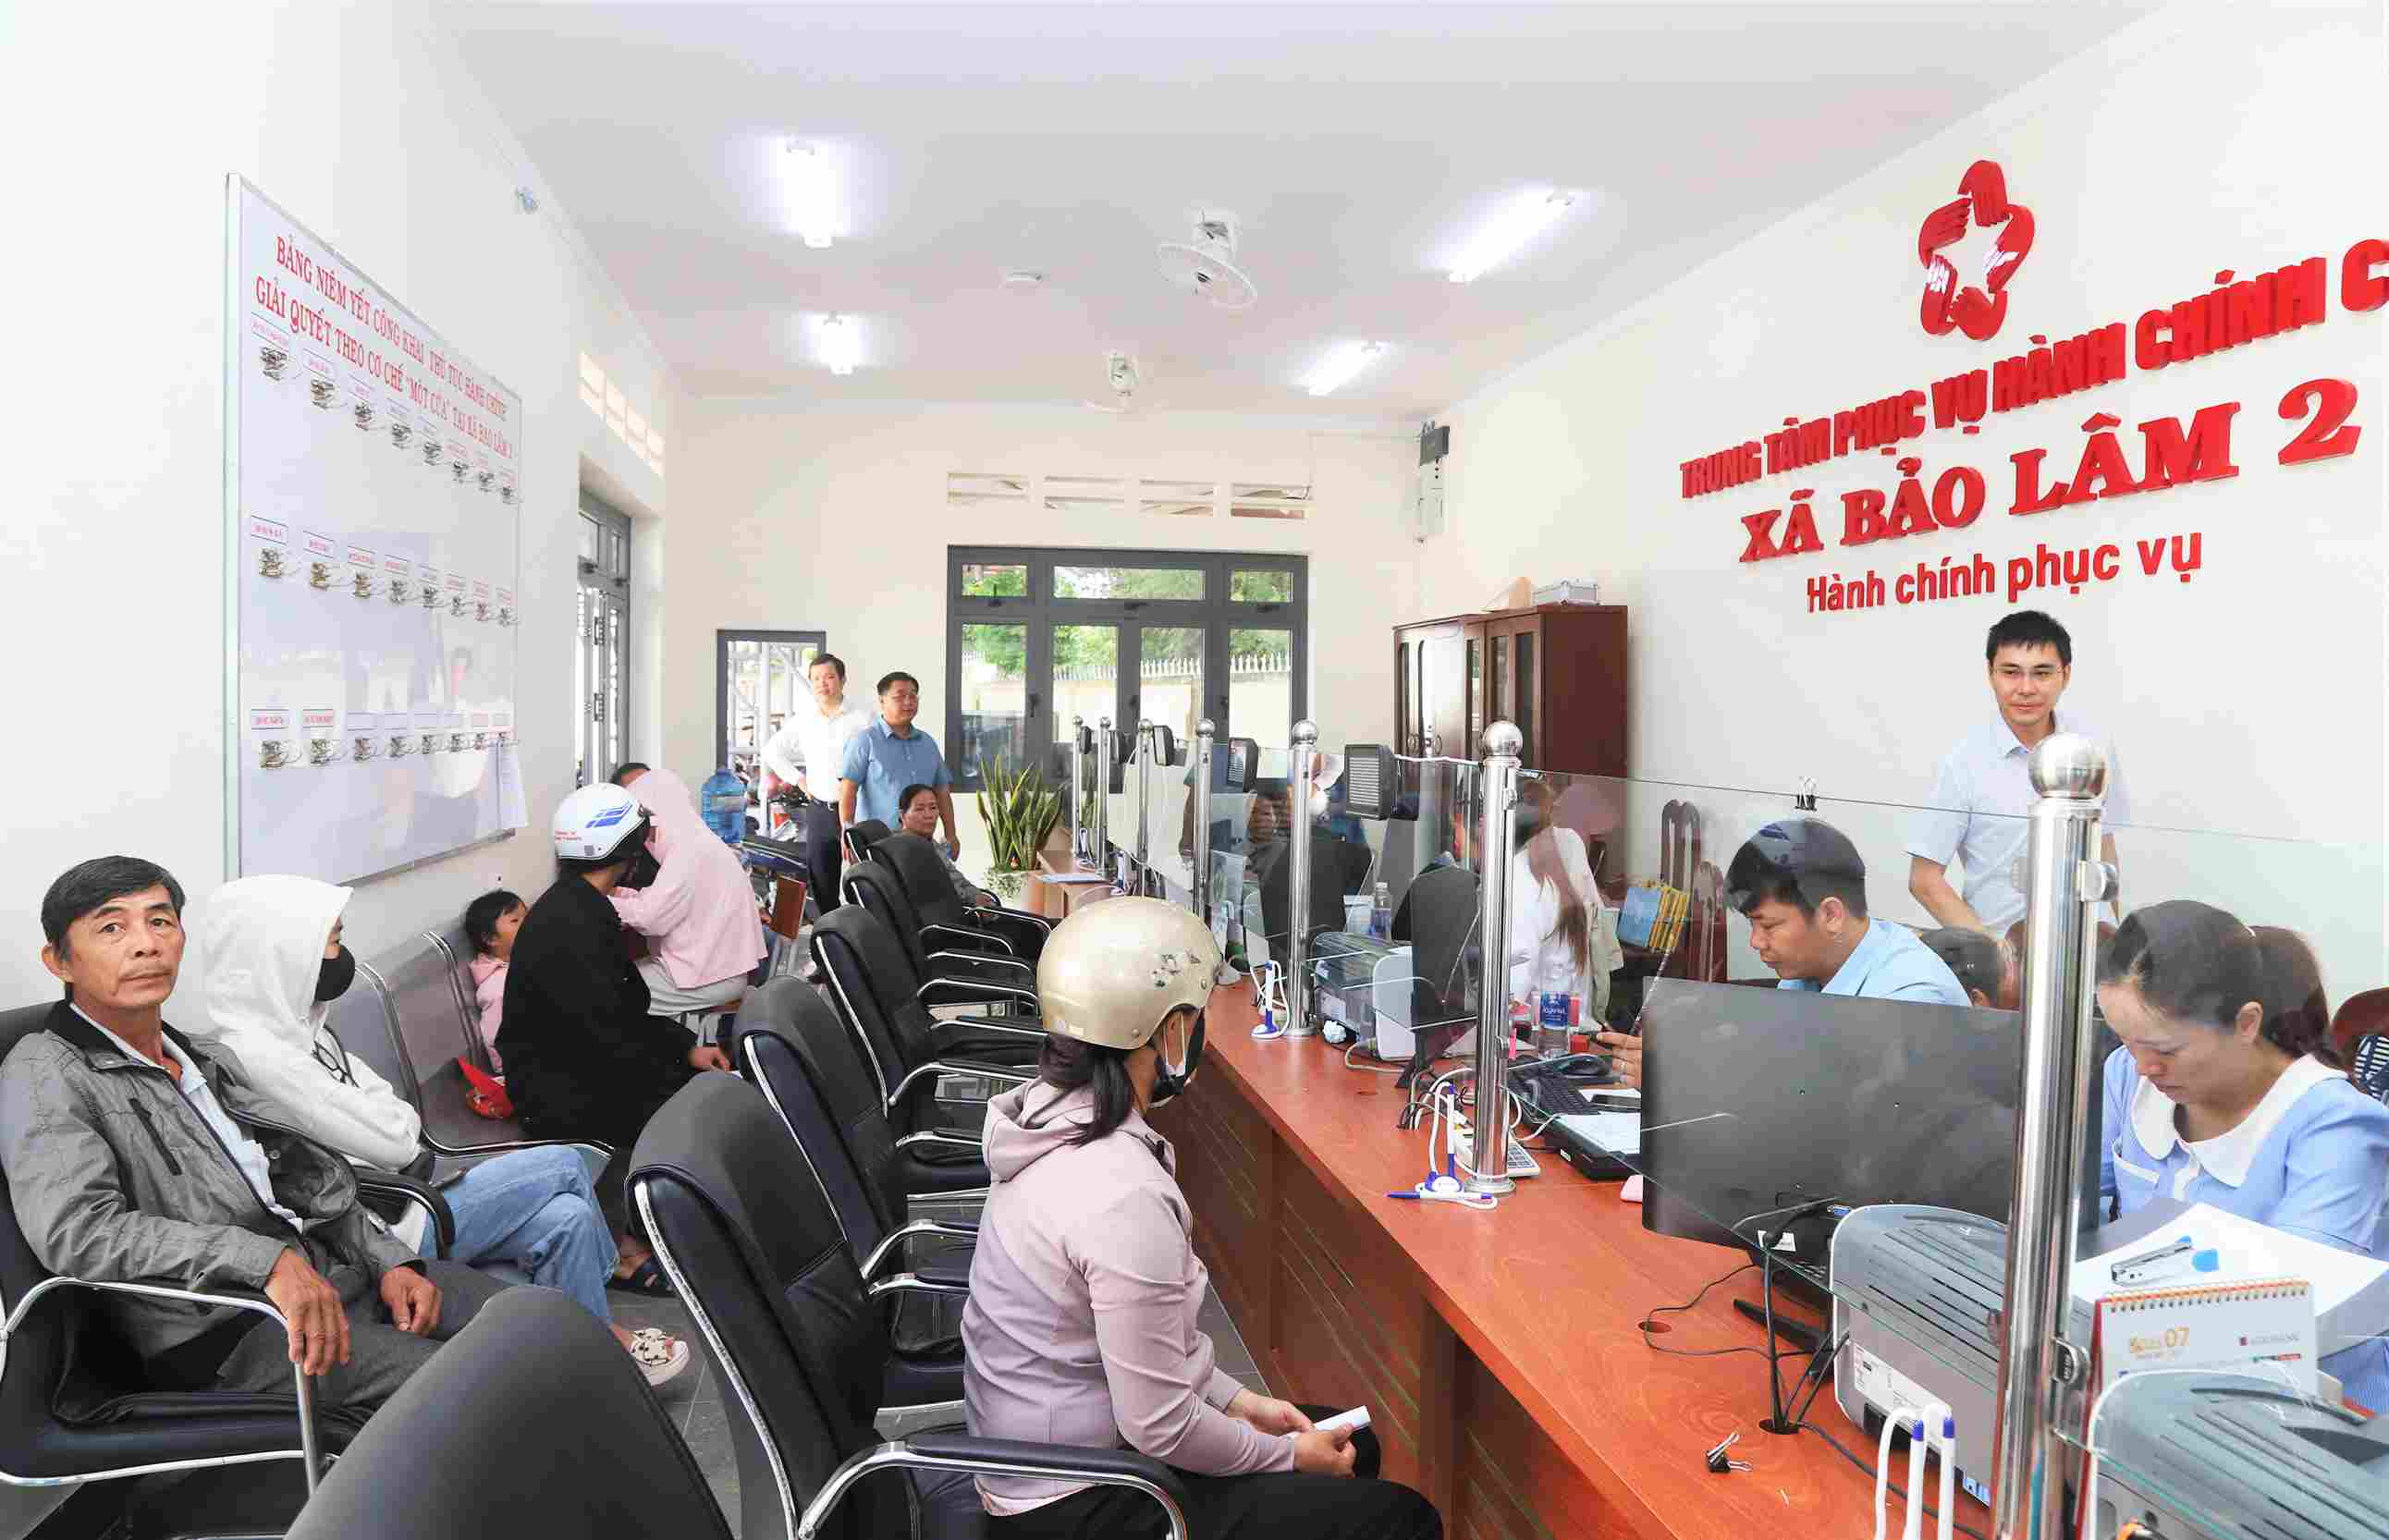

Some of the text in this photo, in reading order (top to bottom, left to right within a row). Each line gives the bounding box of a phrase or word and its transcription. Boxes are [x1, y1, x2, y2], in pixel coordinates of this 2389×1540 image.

[256, 275, 286, 318] GIẢI
[290, 299, 331, 347] QUYẾT
[335, 328, 364, 368] THEO
[385, 361, 404, 392] CHẾ
[276, 233, 311, 284] BẢNG
[316, 265, 347, 310] NIÊM
[349, 287, 370, 325] YẾT
[374, 308, 399, 347] CÔNG
[402, 330, 423, 364] KHAI
[1680, 238, 2389, 498] TRUNG TÂM PHỤC VỤ HÀNH CHÍNH C
[1739, 378, 2361, 562] XÃ BẢO LÂM 2
[1807, 532, 2202, 613] Hành chính phục vụ
